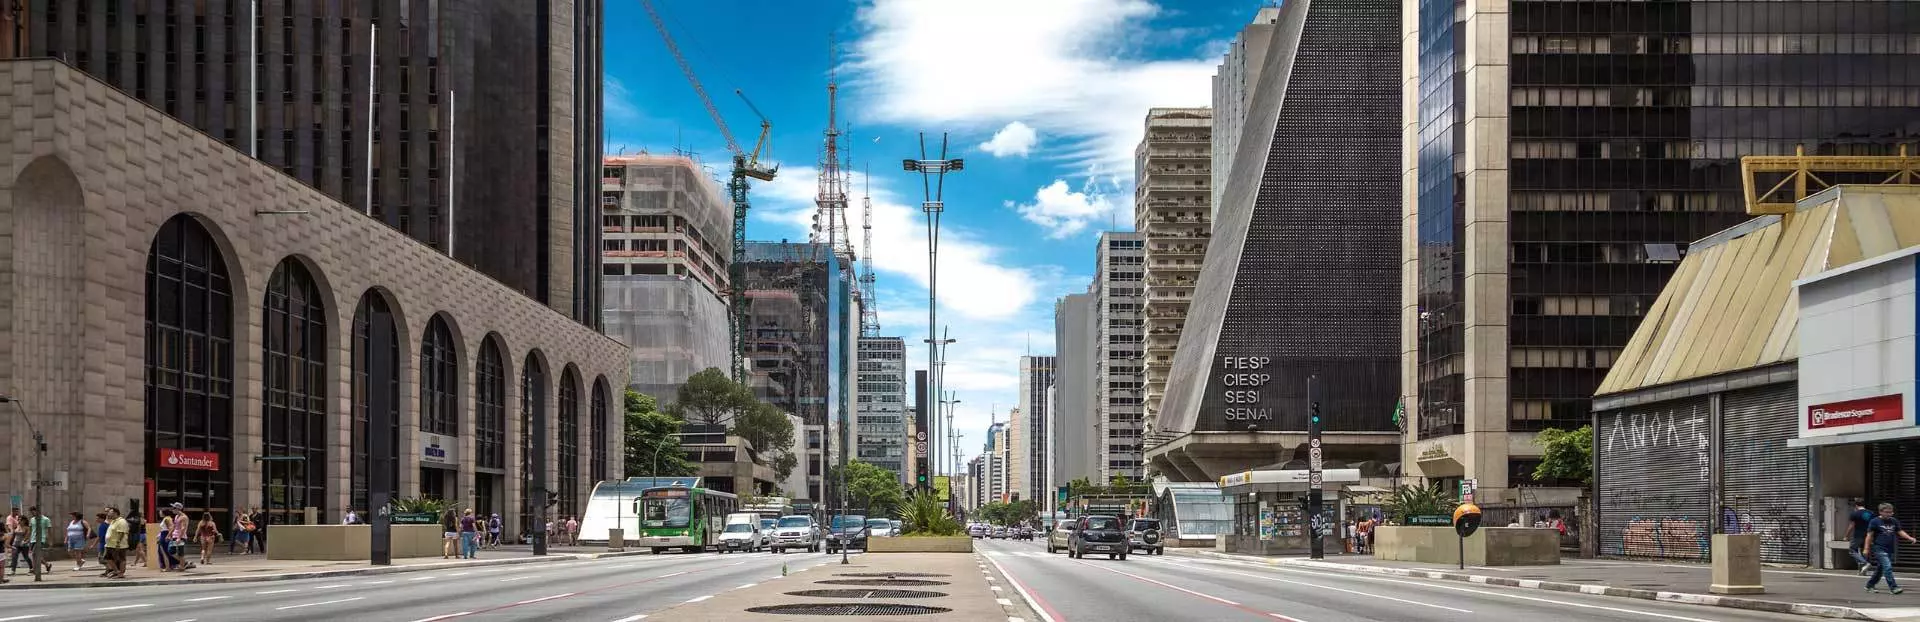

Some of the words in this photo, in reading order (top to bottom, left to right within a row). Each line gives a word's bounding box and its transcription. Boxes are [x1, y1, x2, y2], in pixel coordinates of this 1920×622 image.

[1224, 356, 1270, 370] FIESP
[1223, 373, 1270, 387] CIESP
[1225, 390, 1260, 404] SESI
[1225, 407, 1273, 421] SENAI
[1823, 410, 1851, 421] Bradesco
[1851, 408, 1875, 419] Seguros
[178, 454, 213, 468] Santander
